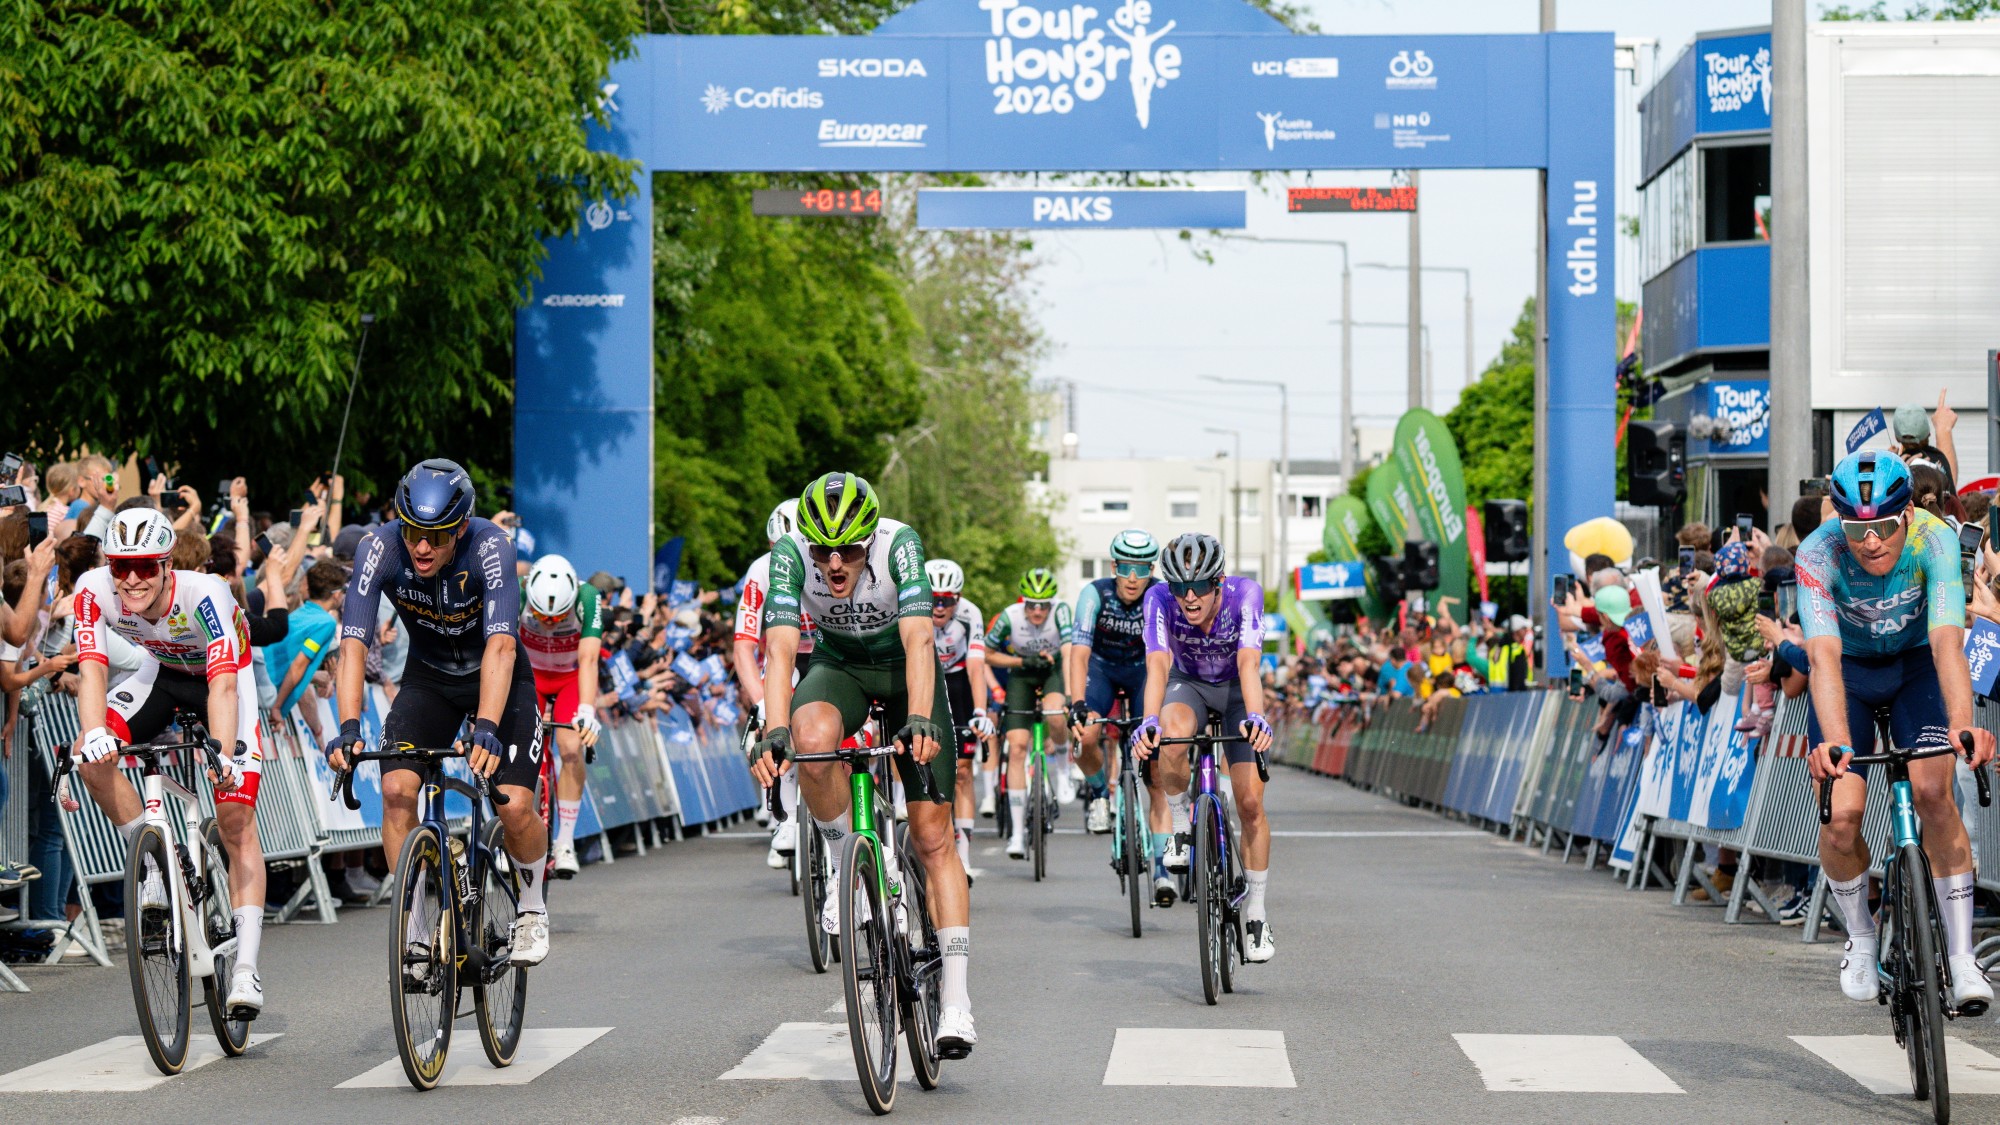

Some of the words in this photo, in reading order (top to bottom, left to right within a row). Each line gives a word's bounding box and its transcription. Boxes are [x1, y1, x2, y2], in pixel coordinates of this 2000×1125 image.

[979, 0, 1098, 41] Tour
[1115, 0, 1152, 27] de
[1252, 61, 1283, 75] UCI
[1704, 52, 1750, 75] Tour
[734, 87, 824, 109] Cofidis
[993, 84, 1074, 115] 2026
[1710, 94, 1742, 113] 2026
[818, 119, 928, 145] Europcar
[801, 189, 881, 213] +0:14
[1033, 197, 1113, 222] PAKS
[1567, 181, 1597, 297] tdh.hu
[1714, 385, 1760, 408] Tour
[141, 524, 154, 548] Pauwels
[358, 537, 385, 597] Q36.5
[481, 552, 503, 590] UBS
[894, 546, 910, 584] RGA
[905, 540, 919, 580] SEGUROS
[775, 554, 794, 594] ALEA
[82, 591, 93, 626] Pauwels
[409, 589, 433, 606] UBS
[829, 602, 880, 616] CAJA
[1936, 581, 1946, 619] ASTANA
[118, 618, 138, 628] Hertz
[199, 601, 222, 637] ALTEZ
[487, 621, 510, 635] SGS
[820, 610, 894, 625] RURAL
[1100, 616, 1145, 629] BAHRAI
[1156, 606, 1168, 649] GIANT
[343, 625, 365, 638] SGS
[1173, 631, 1240, 647] Jayco
